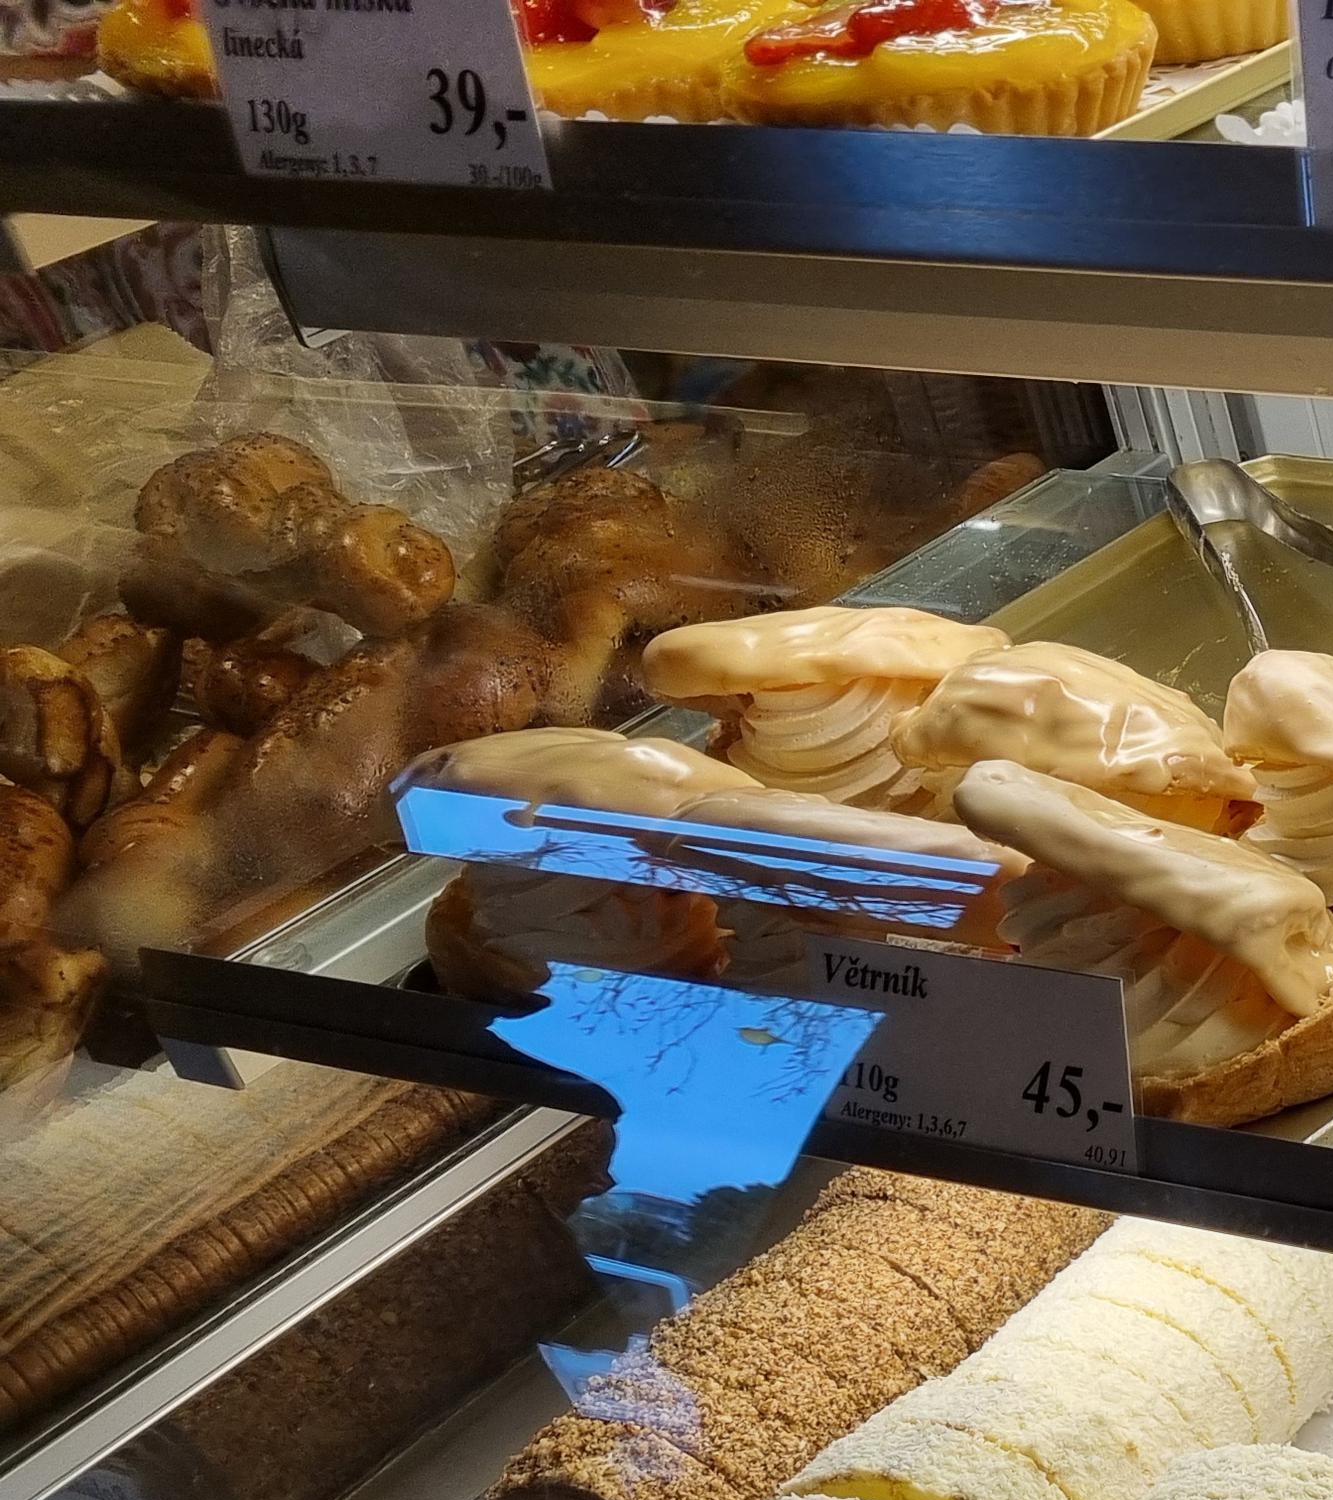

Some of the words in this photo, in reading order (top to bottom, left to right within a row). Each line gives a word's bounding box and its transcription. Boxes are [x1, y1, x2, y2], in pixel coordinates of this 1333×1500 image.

[248, 98, 311, 145] 130g
[426, 67, 527, 151] 39,-
[823, 951, 929, 1000] Větrník
[840, 1100, 912, 1131] Alergeny:
[1022, 1060, 1124, 1133] 45,-
[1084, 1144, 1127, 1168] 40,91
